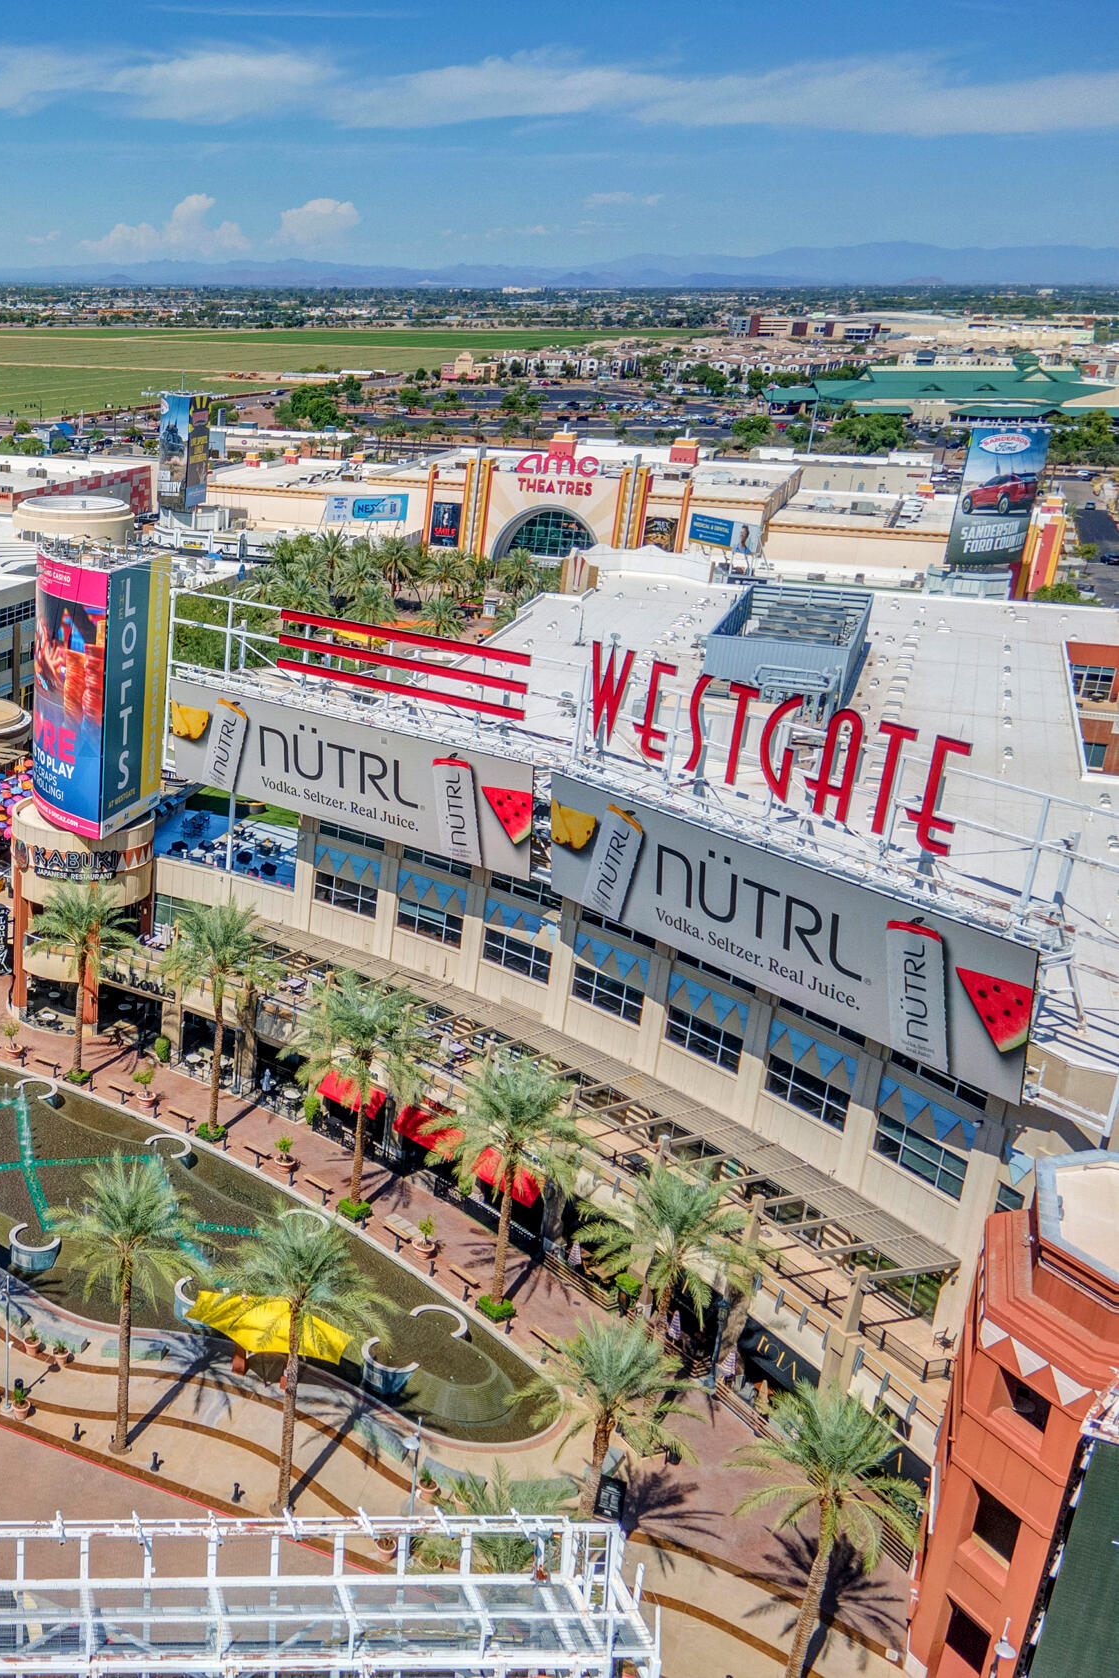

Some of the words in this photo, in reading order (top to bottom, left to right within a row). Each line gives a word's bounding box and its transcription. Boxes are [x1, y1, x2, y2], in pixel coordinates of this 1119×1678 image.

[995, 441, 1018, 452] Ford
[517, 477, 593, 497] THEATRES
[433, 526, 457, 537] SMILE
[960, 520, 1021, 541] SANDERSON
[963, 538, 994, 554] FORD
[592, 640, 974, 857] WESTGATE
[37, 747, 46, 764] TO
[46, 755, 75, 780] PLAY
[261, 775, 301, 798] Vodka.
[303, 788, 347, 812] Seltzer.
[350, 801, 378, 822] Real
[380, 809, 420, 832] Juice.
[34, 845, 119, 870] KABUKI
[36, 868, 68, 880] JAPANESE
[70, 871, 113, 881] RESTAURANT
[655, 907, 705, 942] Vodka.
[707, 930, 765, 969] Seltzer.
[768, 957, 805, 985] Real
[807, 977, 861, 1012] Juice.
